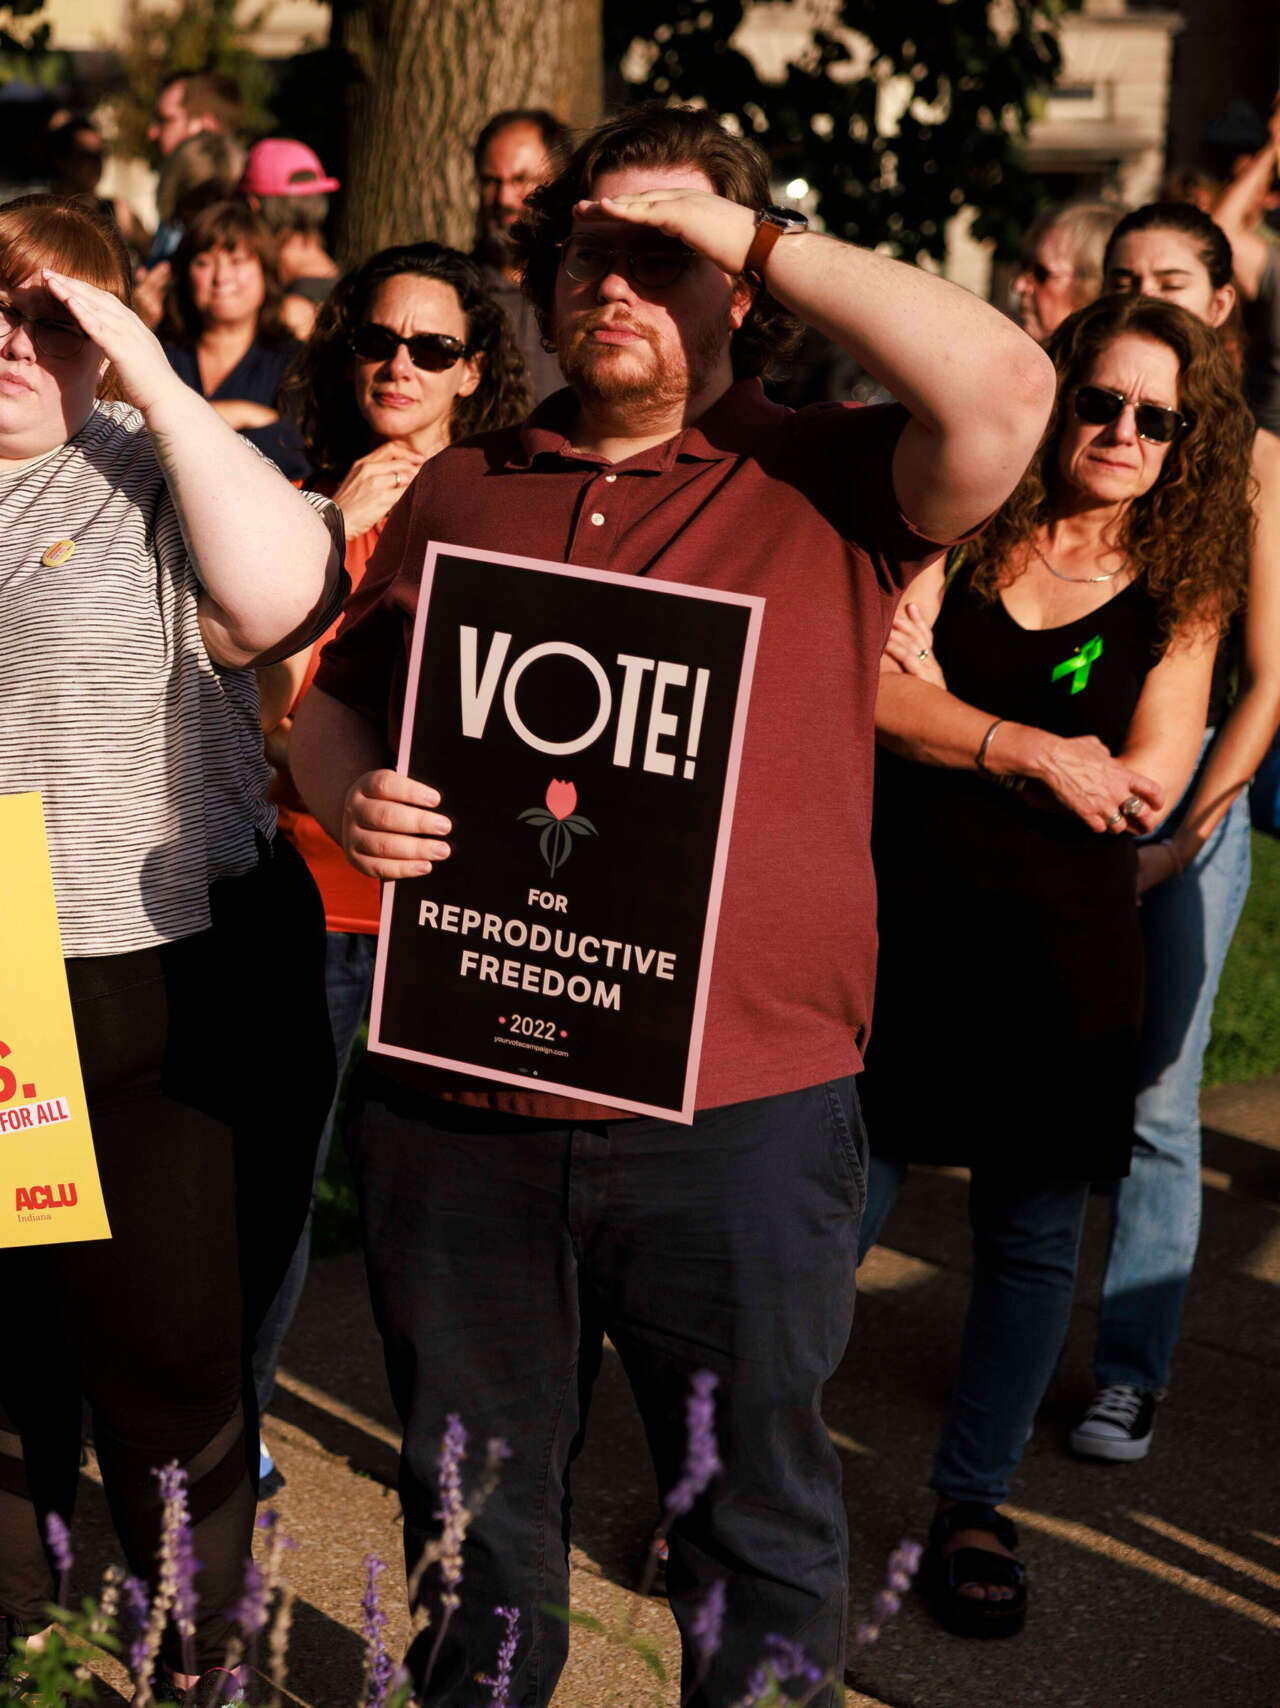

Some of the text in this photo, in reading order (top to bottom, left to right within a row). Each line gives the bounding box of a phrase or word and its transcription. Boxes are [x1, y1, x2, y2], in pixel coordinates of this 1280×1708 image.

[460, 625, 710, 780] VOTE!
[528, 888, 568, 913] FOR
[418, 899, 677, 980] REPRODUCTIVE
[460, 950, 621, 1011] FREEDOM
[510, 1014, 556, 1041] 2022
[0, 1107, 33, 1132] FOR
[37, 1100, 68, 1126] ALL
[16, 1183, 78, 1211] ACLU
[17, 1214, 52, 1223] Indiana
